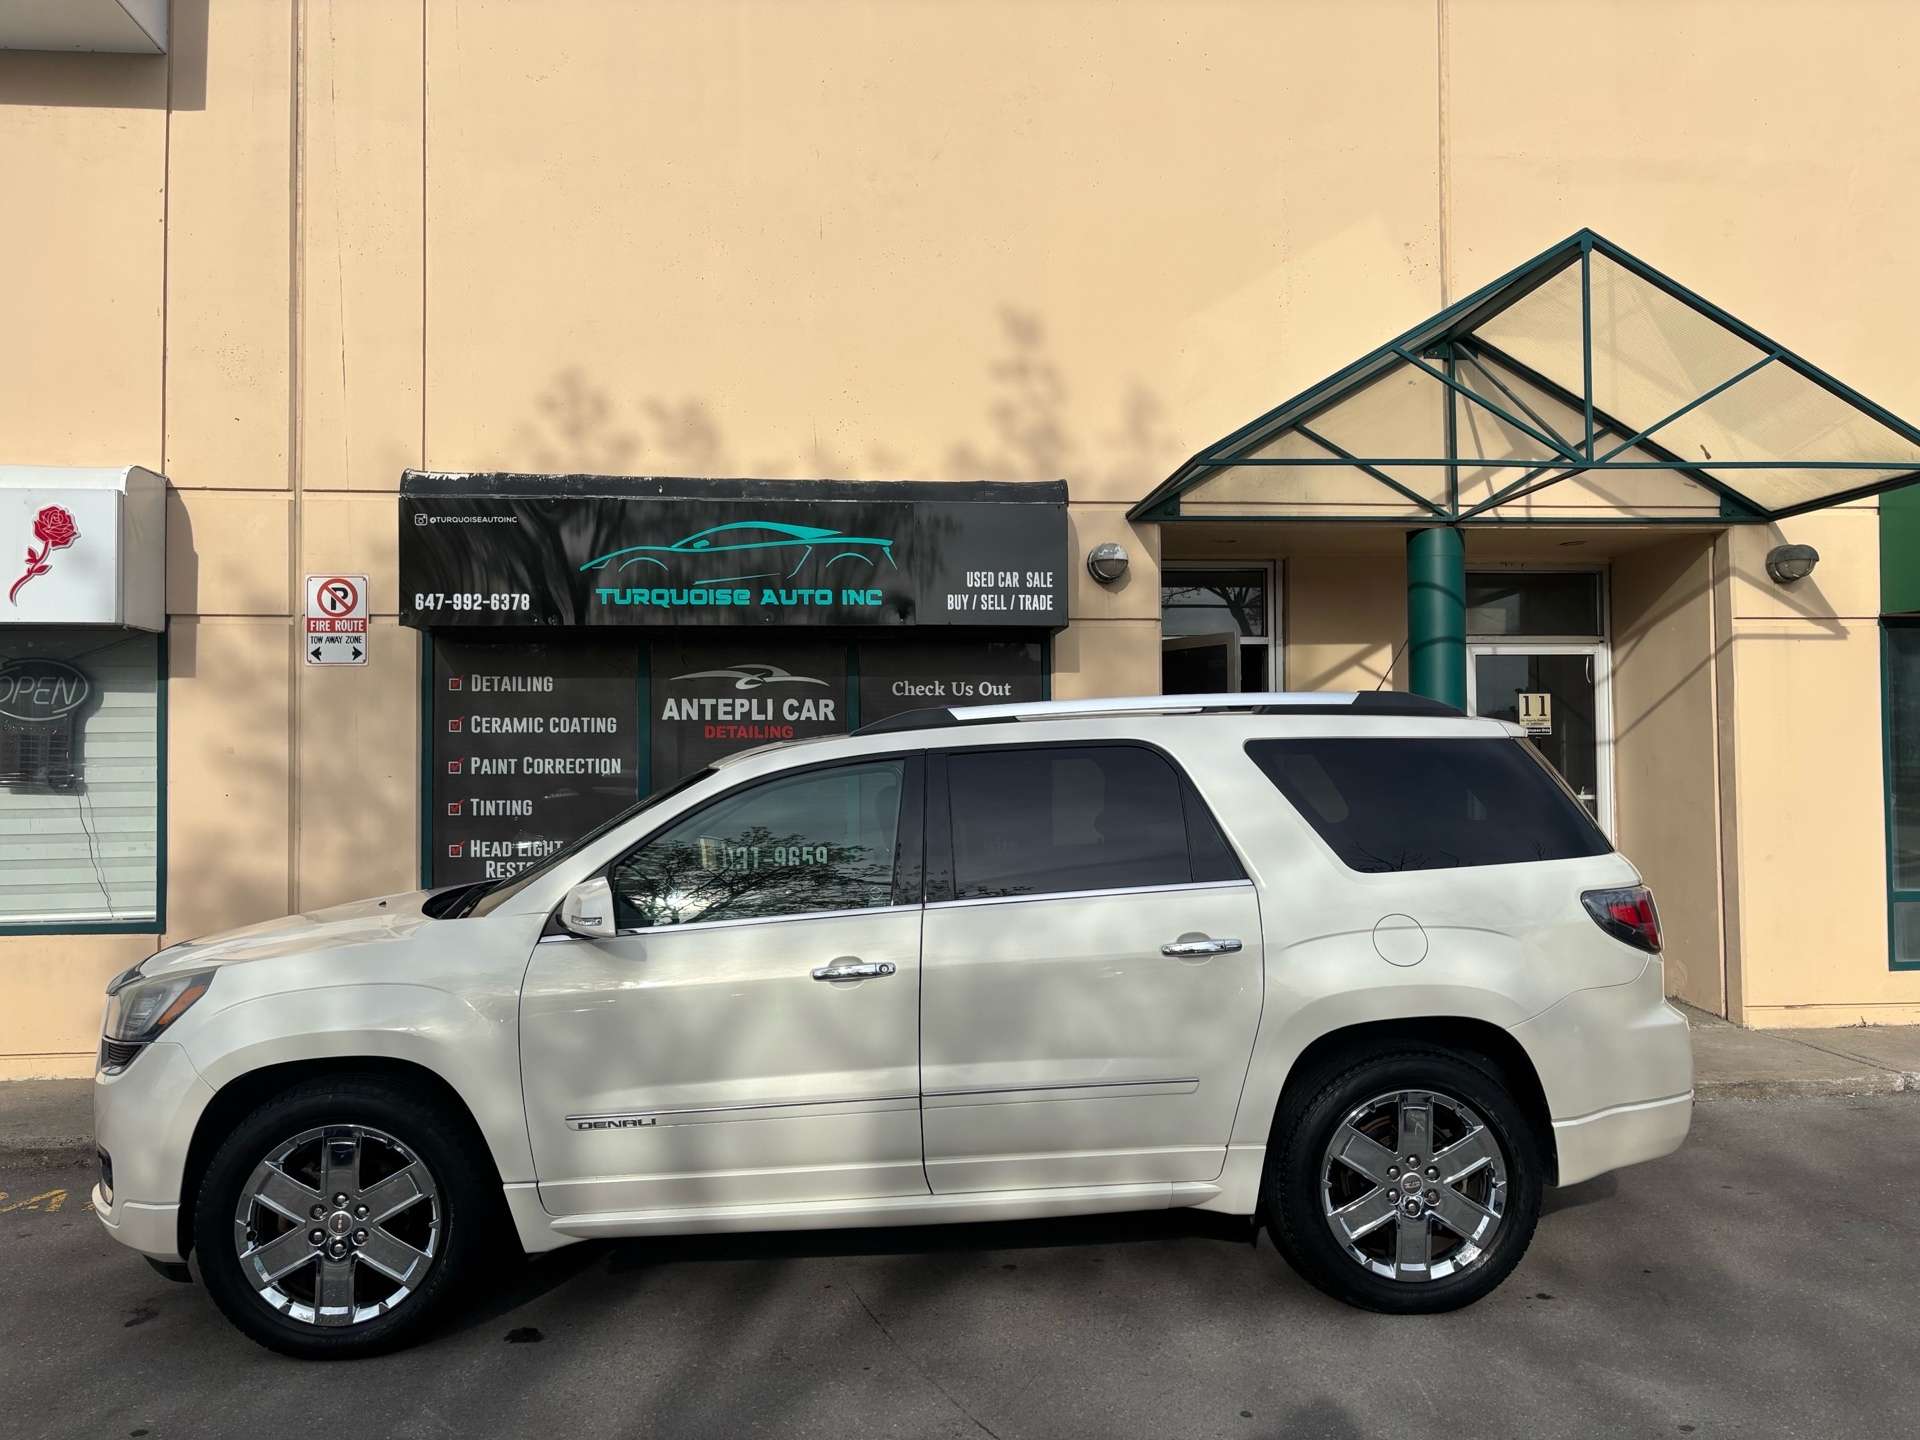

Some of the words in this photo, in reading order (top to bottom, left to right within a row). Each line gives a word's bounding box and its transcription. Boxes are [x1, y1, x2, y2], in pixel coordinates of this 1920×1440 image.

[966, 571, 995, 588] USED
[998, 571, 1020, 588] CAR
[1026, 571, 1053, 588] SALE
[415, 593, 530, 611] 647-992-6378
[760, 589, 833, 606] AUTO
[842, 589, 883, 606] INC
[947, 594, 969, 611] BUY
[980, 594, 1008, 611] SELL
[1018, 594, 1054, 611] TRADE
[310, 620, 331, 631] FIRE
[335, 620, 364, 632] ROUTE
[310, 636, 323, 645] TOW
[324, 636, 343, 645] AWAY
[345, 636, 362, 645] ZONE
[0, 676, 78, 704] OPEN
[471, 674, 554, 693] DETAILING
[892, 681, 945, 697] Check
[952, 681, 974, 697] Us
[978, 681, 1012, 697] Out
[661, 698, 774, 721] ANTEPLI
[782, 698, 836, 721] CAR
[1523, 696, 1547, 716] 11
[471, 715, 544, 734] CERAMIC
[549, 716, 617, 734] COATING
[704, 725, 794, 739] DETAILING
[471, 757, 518, 775] PAINT
[523, 757, 622, 775] CORRECTION
[470, 798, 533, 816] TINTING
[470, 840, 512, 858] HEAD
[485, 860, 535, 879] REST
[577, 1118, 657, 1130] DENALI
